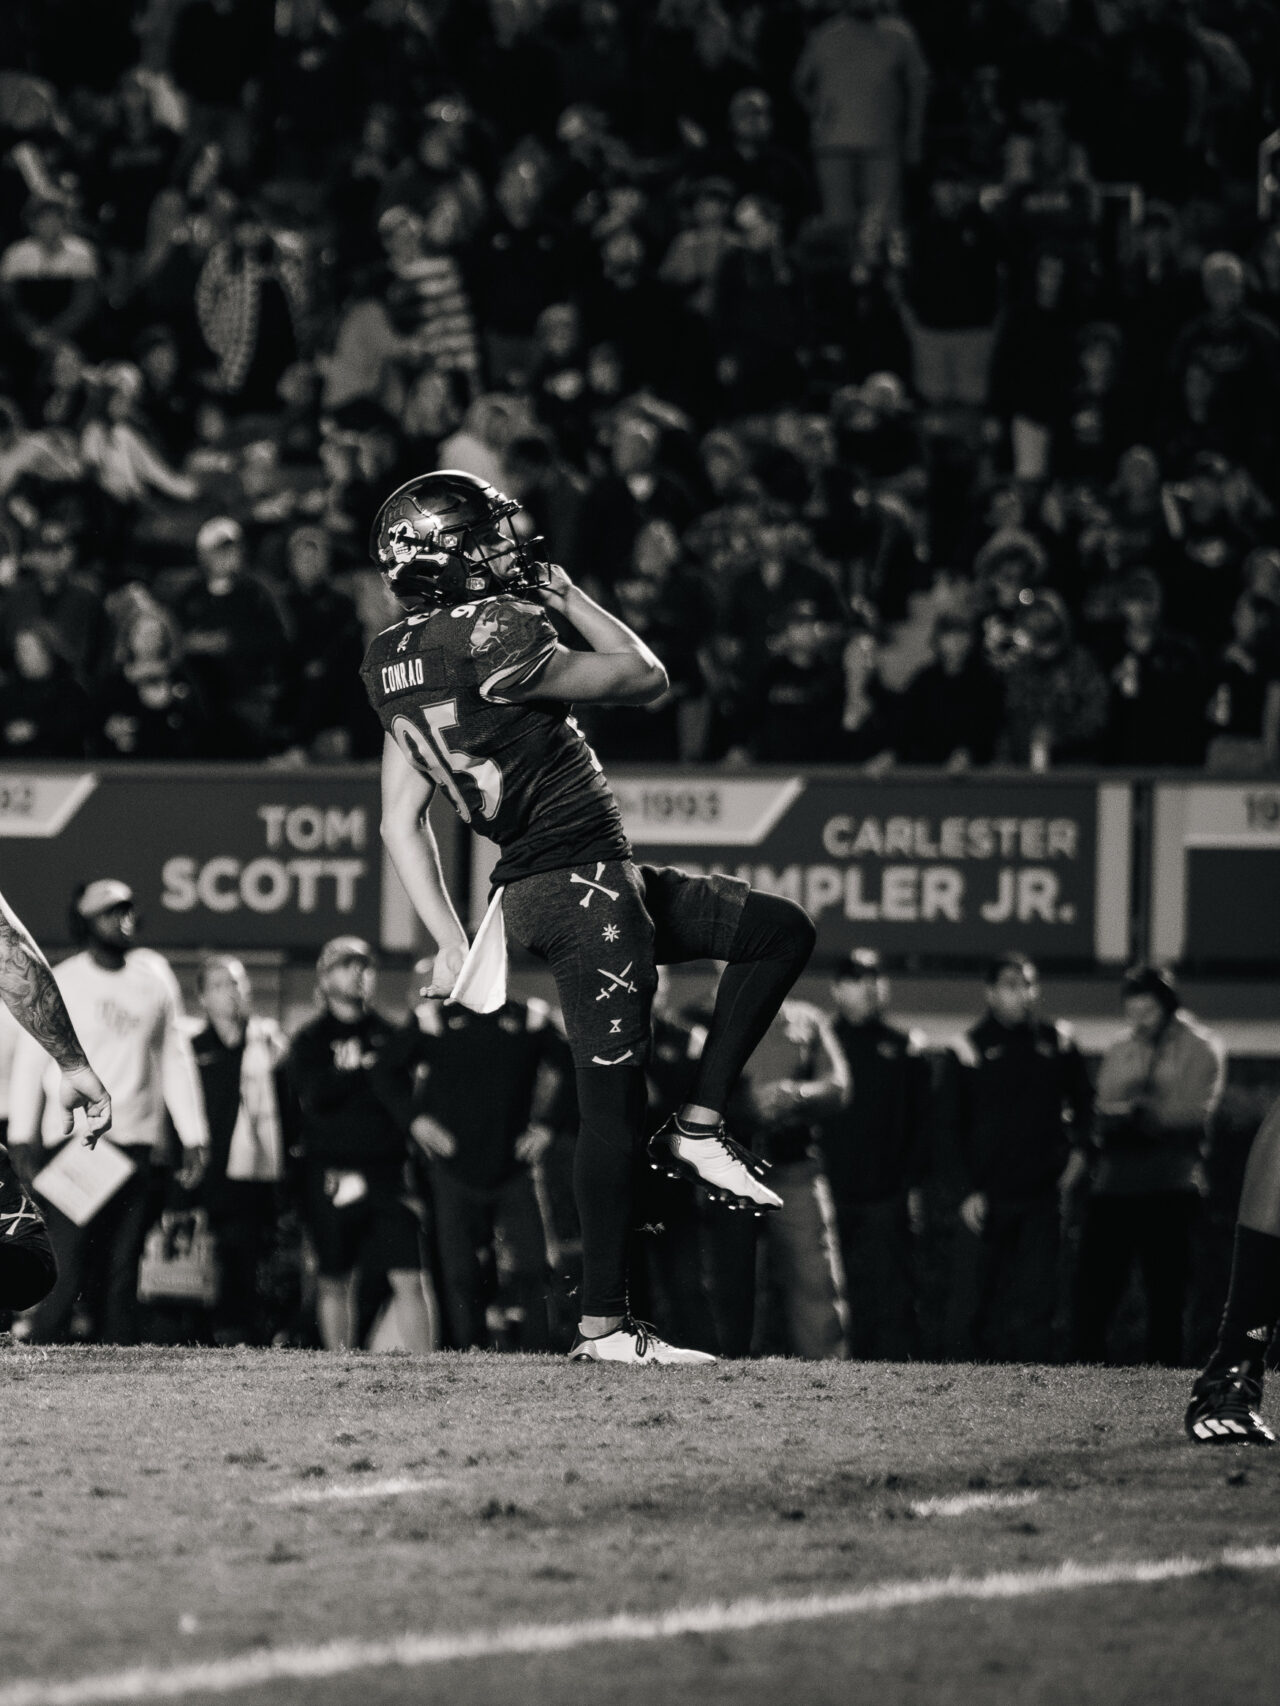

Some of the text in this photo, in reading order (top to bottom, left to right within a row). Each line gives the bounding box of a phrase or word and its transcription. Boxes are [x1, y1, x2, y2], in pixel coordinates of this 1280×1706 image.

[381, 658, 424, 694] CONRAD
[391, 699, 503, 823] 95
[257, 805, 366, 851] TOM
[823, 815, 1077, 859] CARLESTER
[161, 856, 364, 913] SCOTT
[677, 864, 1075, 923] MPLER JR.
